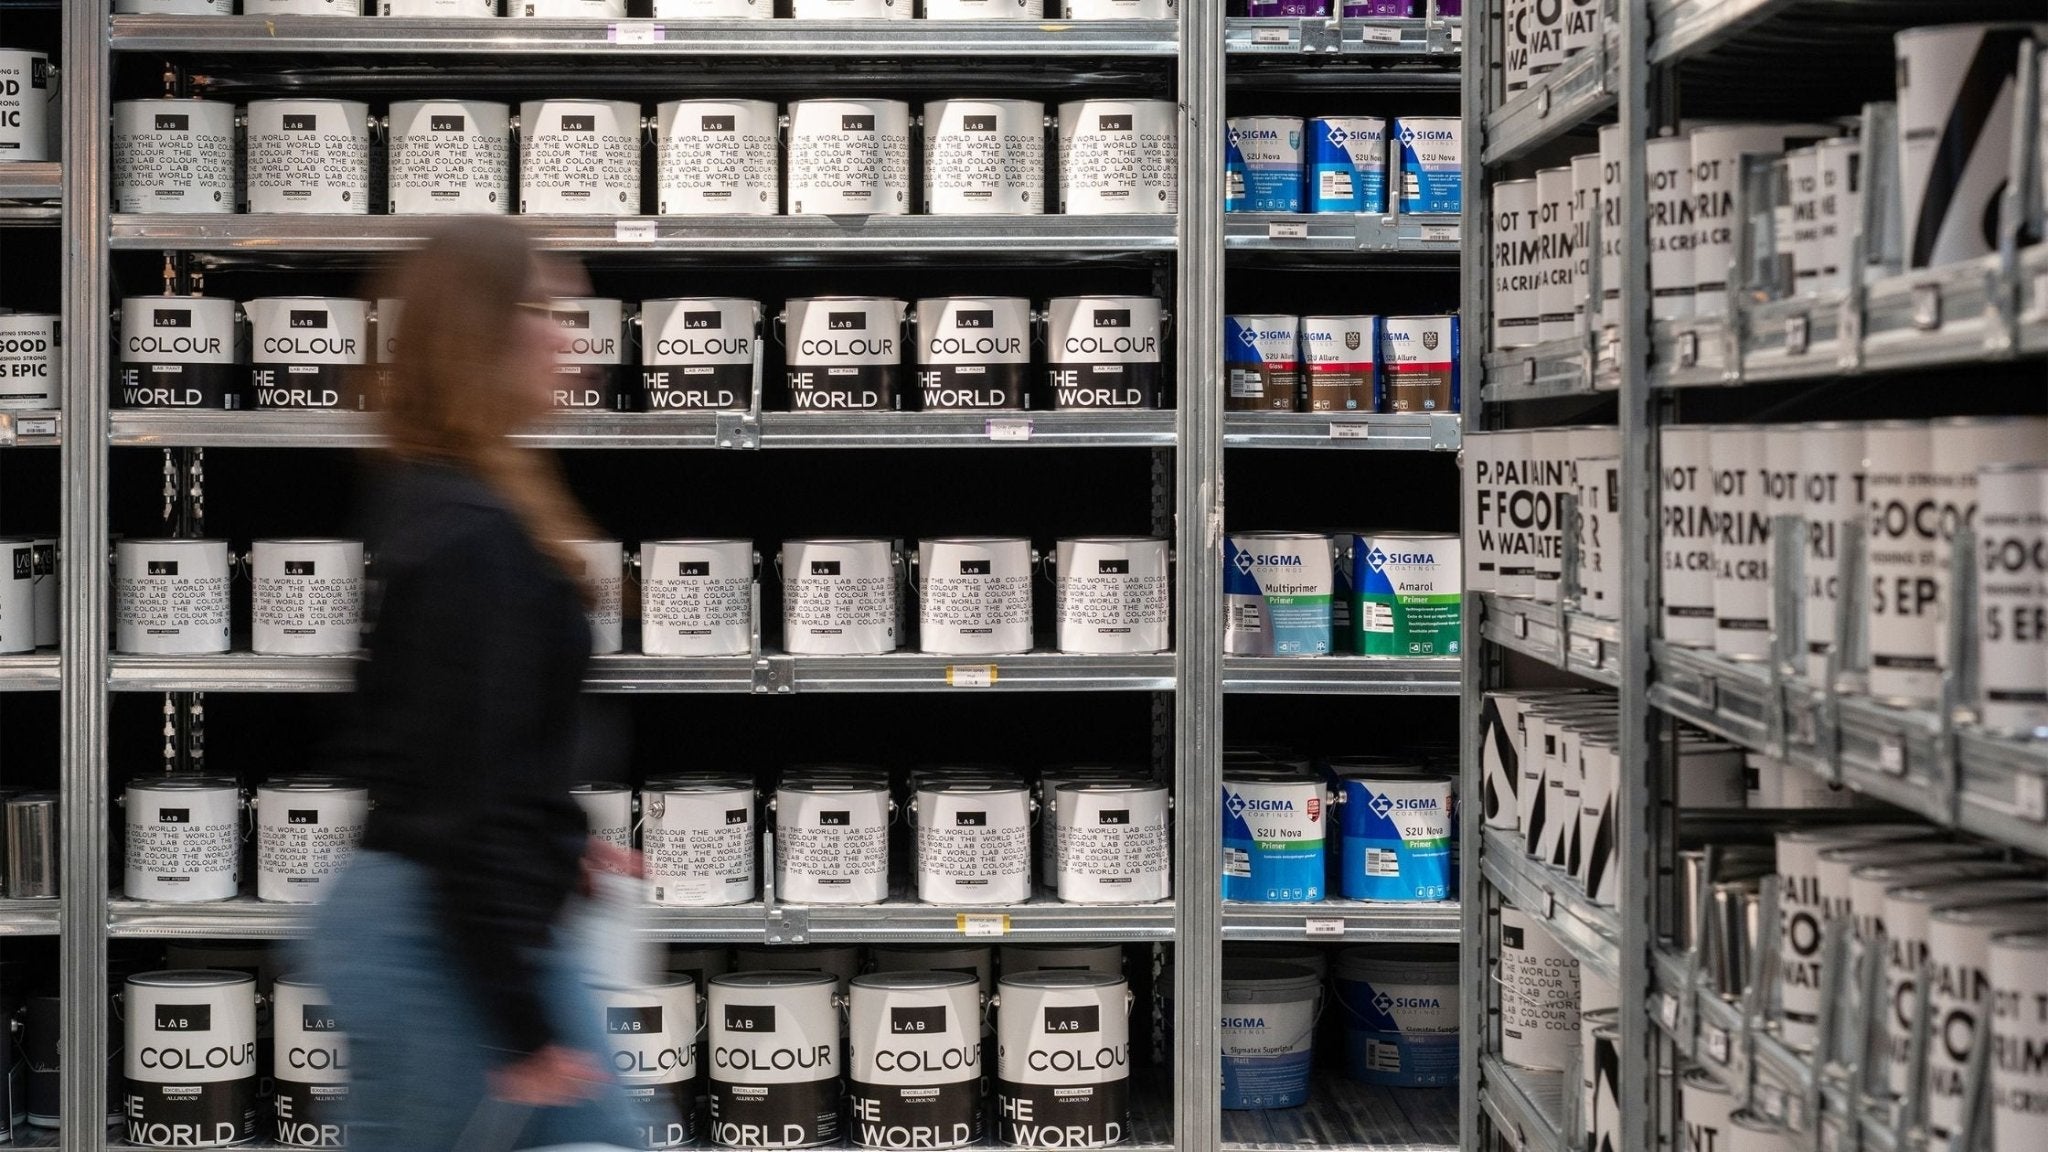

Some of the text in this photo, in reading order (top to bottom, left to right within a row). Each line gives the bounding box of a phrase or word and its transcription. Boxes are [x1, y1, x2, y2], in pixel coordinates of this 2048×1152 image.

[1242, 131, 1277, 139] SIGMA
[1350, 131, 1381, 140] SIGMA
[1417, 131, 1453, 139] SIGMA
[1260, 331, 1290, 339] SIGMA
[129, 337, 220, 353] COLOUR
[264, 337, 355, 354] COLOUR
[657, 338, 749, 355] COLOUR
[802, 339, 893, 355] COLOUR
[930, 338, 1021, 354] COLOUR
[1066, 337, 1156, 353] COLOUR
[12, 363, 47, 377] EPIC
[124, 388, 202, 405] WORLD
[258, 389, 338, 406] WORLD
[651, 390, 734, 408] WORLD
[795, 391, 877, 408] WORLD
[924, 390, 1005, 406] WORLD
[1058, 389, 1141, 405] WORLD
[1257, 555, 1301, 565] SIGMA
[1390, 554, 1434, 563] SIGMA
[1265, 584, 1318, 594] Multiprimer
[1399, 582, 1433, 591] Amarol
[1249, 800, 1293, 810] SIGMA
[1396, 799, 1437, 810] SIGMA
[1258, 828, 1301, 837] S2U Nova
[1406, 827, 1443, 836] S2U Nova
[1396, 998, 1440, 1008] SIGMA
[158, 1019, 188, 1028] LAB
[306, 1019, 335, 1028] LAB
[611, 1022, 641, 1030] LAB
[727, 1019, 753, 1028] LAB
[894, 1021, 925, 1030] LAB
[1048, 1021, 1079, 1030] LAB
[1221, 1018, 1265, 1028] SIGMA
[141, 1042, 255, 1070] COLOUR
[715, 1045, 831, 1071] COLOUR
[1028, 1042, 1130, 1072] COLOU
[128, 1120, 235, 1146] WORLD
[861, 1123, 969, 1148] WORLD
[1013, 1122, 1121, 1147] WORLD
